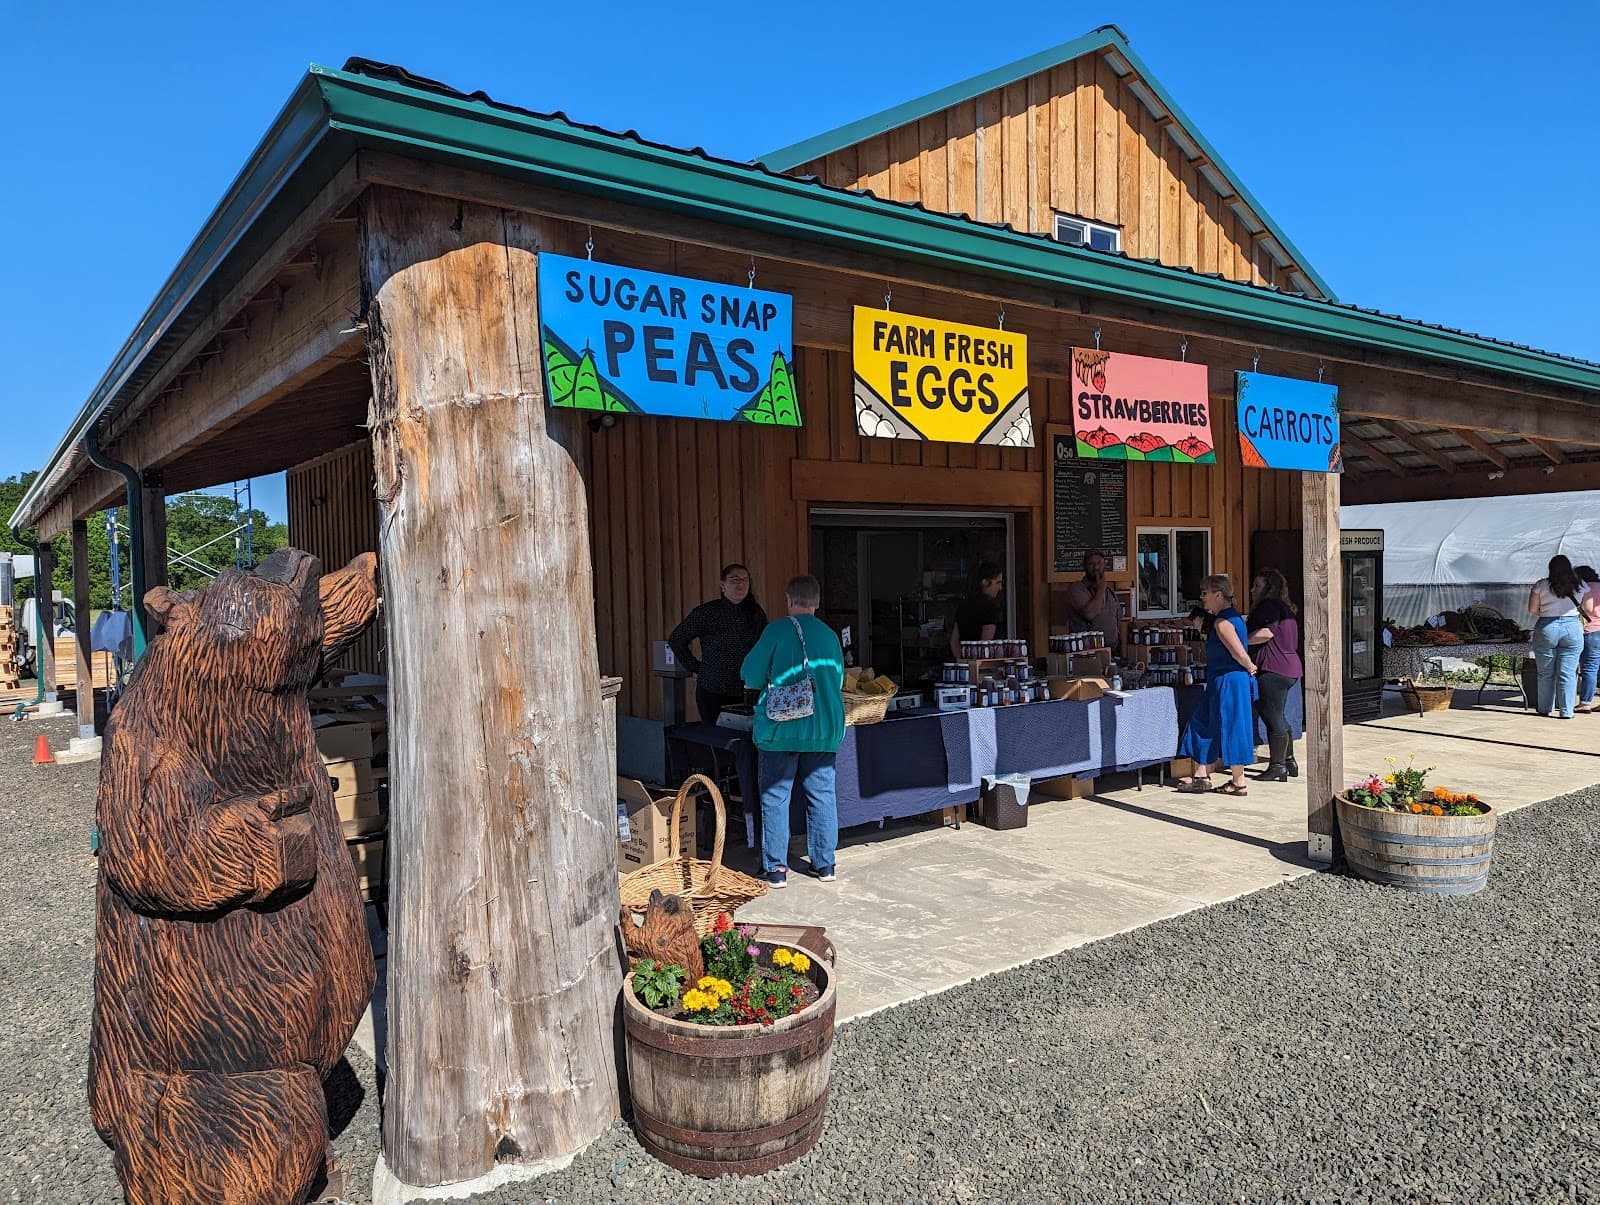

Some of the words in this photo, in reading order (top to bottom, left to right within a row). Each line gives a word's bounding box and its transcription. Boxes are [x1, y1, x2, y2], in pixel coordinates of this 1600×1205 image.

[565, 270, 687, 320] SUGAR
[701, 293, 777, 332] SNAP
[603, 319, 760, 393] PEAS
[873, 320, 935, 358] FARM
[944, 332, 1013, 370] FRESH
[890, 360, 999, 415] EGGS
[1078, 391, 1208, 427] STRAWBERRIES
[1244, 405, 1334, 445] CARROTS
[1354, 536, 1381, 545] PRODUCE
